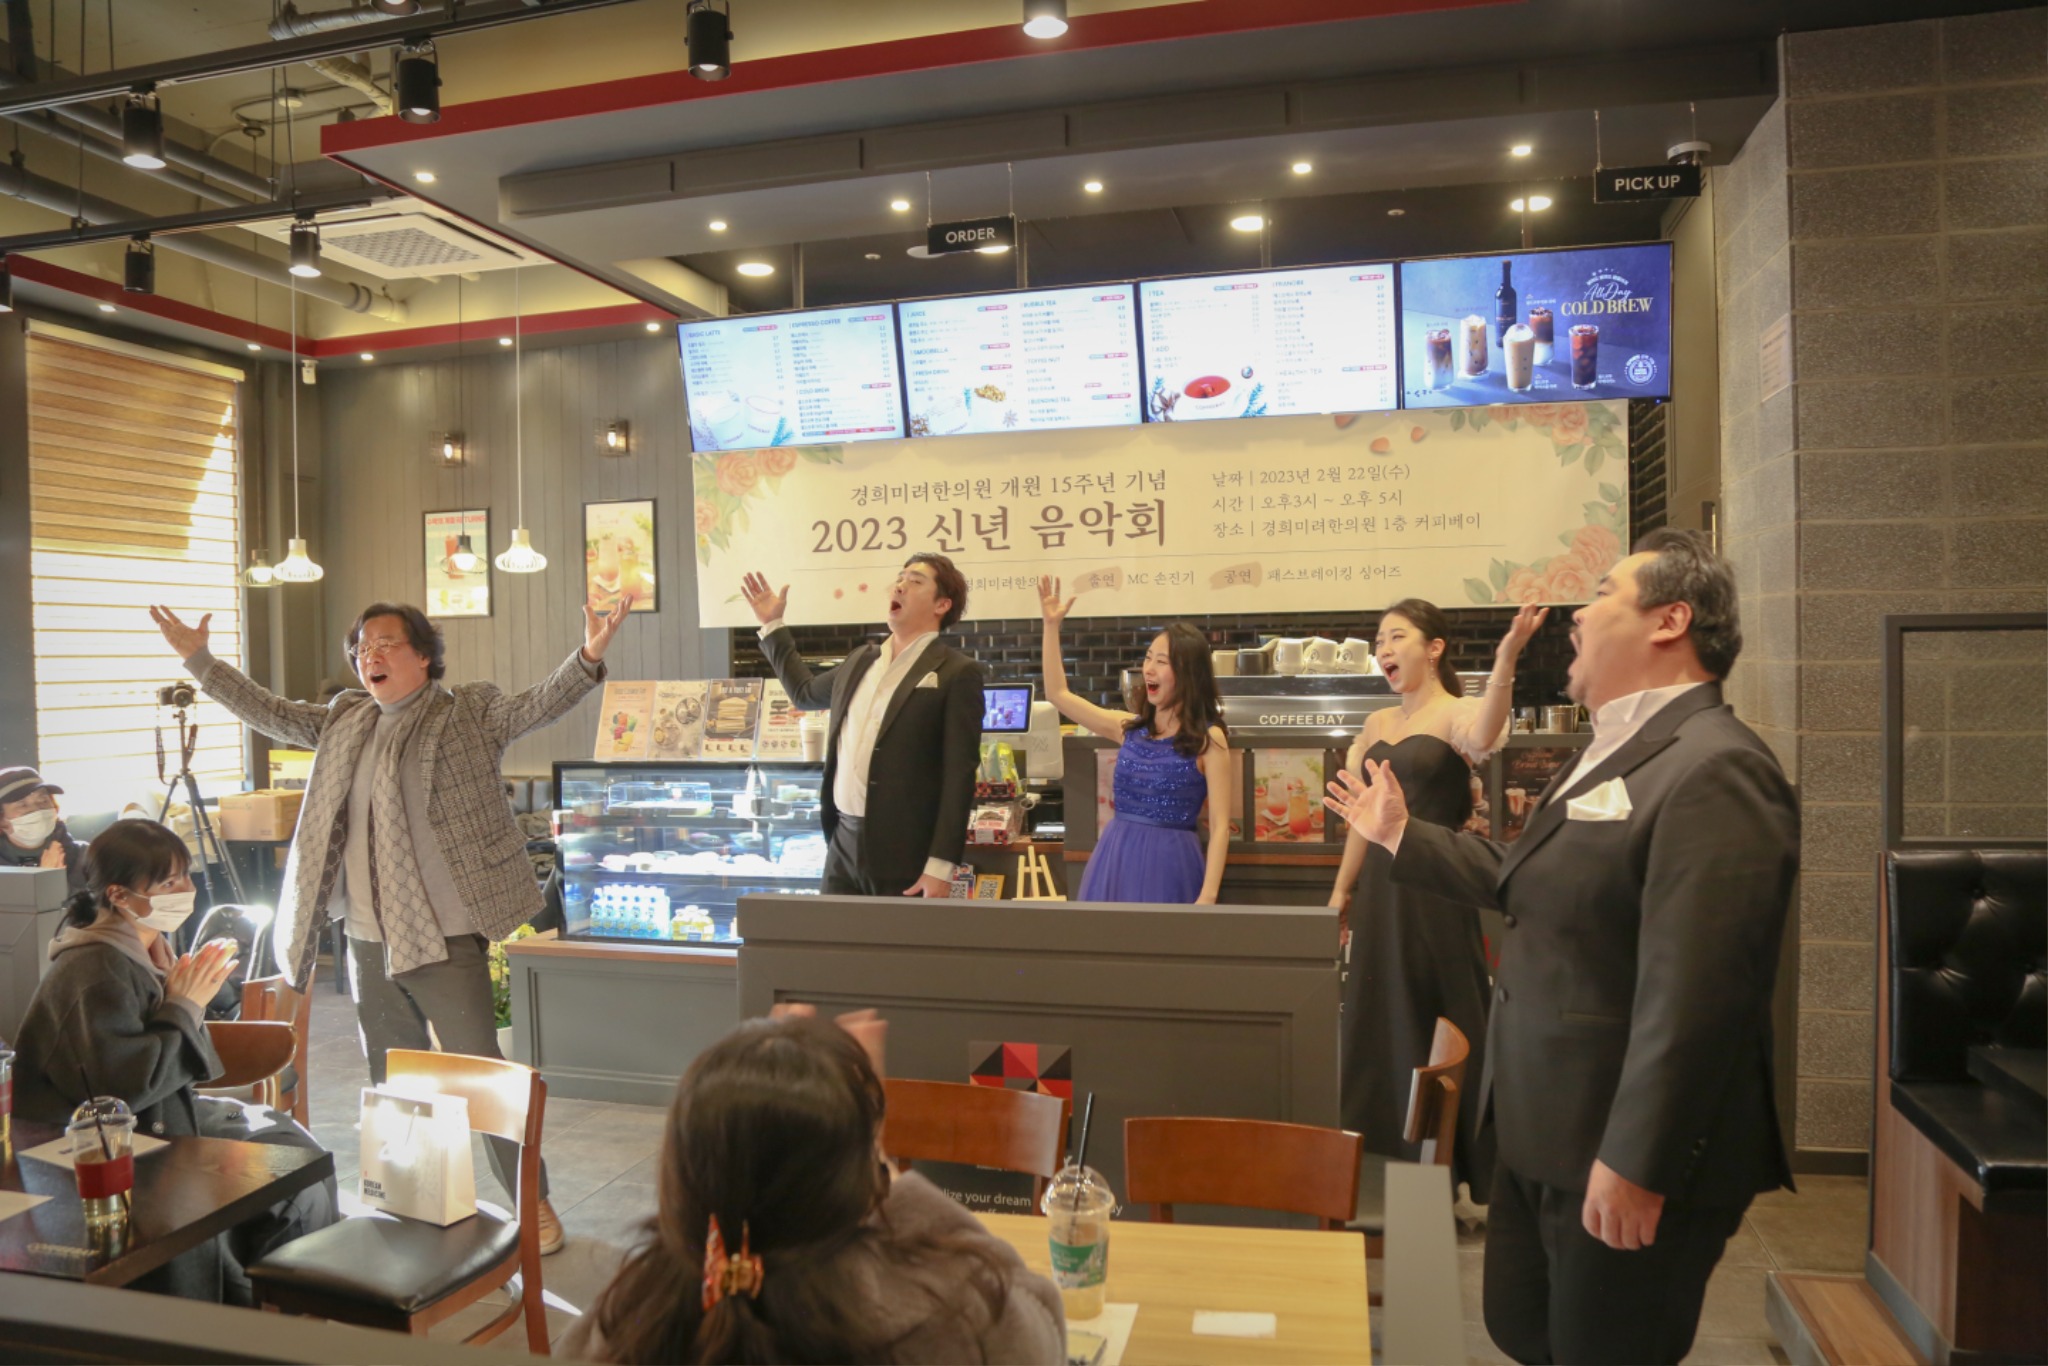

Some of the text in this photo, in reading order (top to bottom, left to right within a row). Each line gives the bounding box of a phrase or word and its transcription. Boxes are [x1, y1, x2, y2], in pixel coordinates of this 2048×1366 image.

[1615, 173, 1682, 193] PICK UP
[945, 227, 996, 244] ORDER
[1561, 297, 1654, 317] COLD BREW
[820, 317, 841, 326] COFFEE
[705, 329, 721, 337] LATTE
[1212, 464, 1411, 487] 날짜 2023년 2월 22일(수)
[850, 469, 1167, 507] 경희미려한의원 개원 15주년 기념
[1212, 495, 1244, 513] 시간
[1261, 492, 1317, 511] 오후3시
[1340, 490, 1373, 508] 오후
[1379, 489, 1403, 507] 5시
[811, 498, 1166, 554] 2023 신년 음악회
[1213, 512, 1482, 539] 장소 경희미려한의원 1층 커피베이
[1088, 572, 1116, 589] 출연
[1127, 572, 1148, 586] MC
[1154, 569, 1195, 587] 손진기
[1223, 568, 1252, 584] 공연
[1267, 566, 1353, 583] 패스브레이킹
[1359, 564, 1402, 580] 싱어즈
[1258, 714, 1346, 726] COFFEE BAY
[965, 1192, 991, 1204] your
[993, 1193, 1032, 1207] dream
